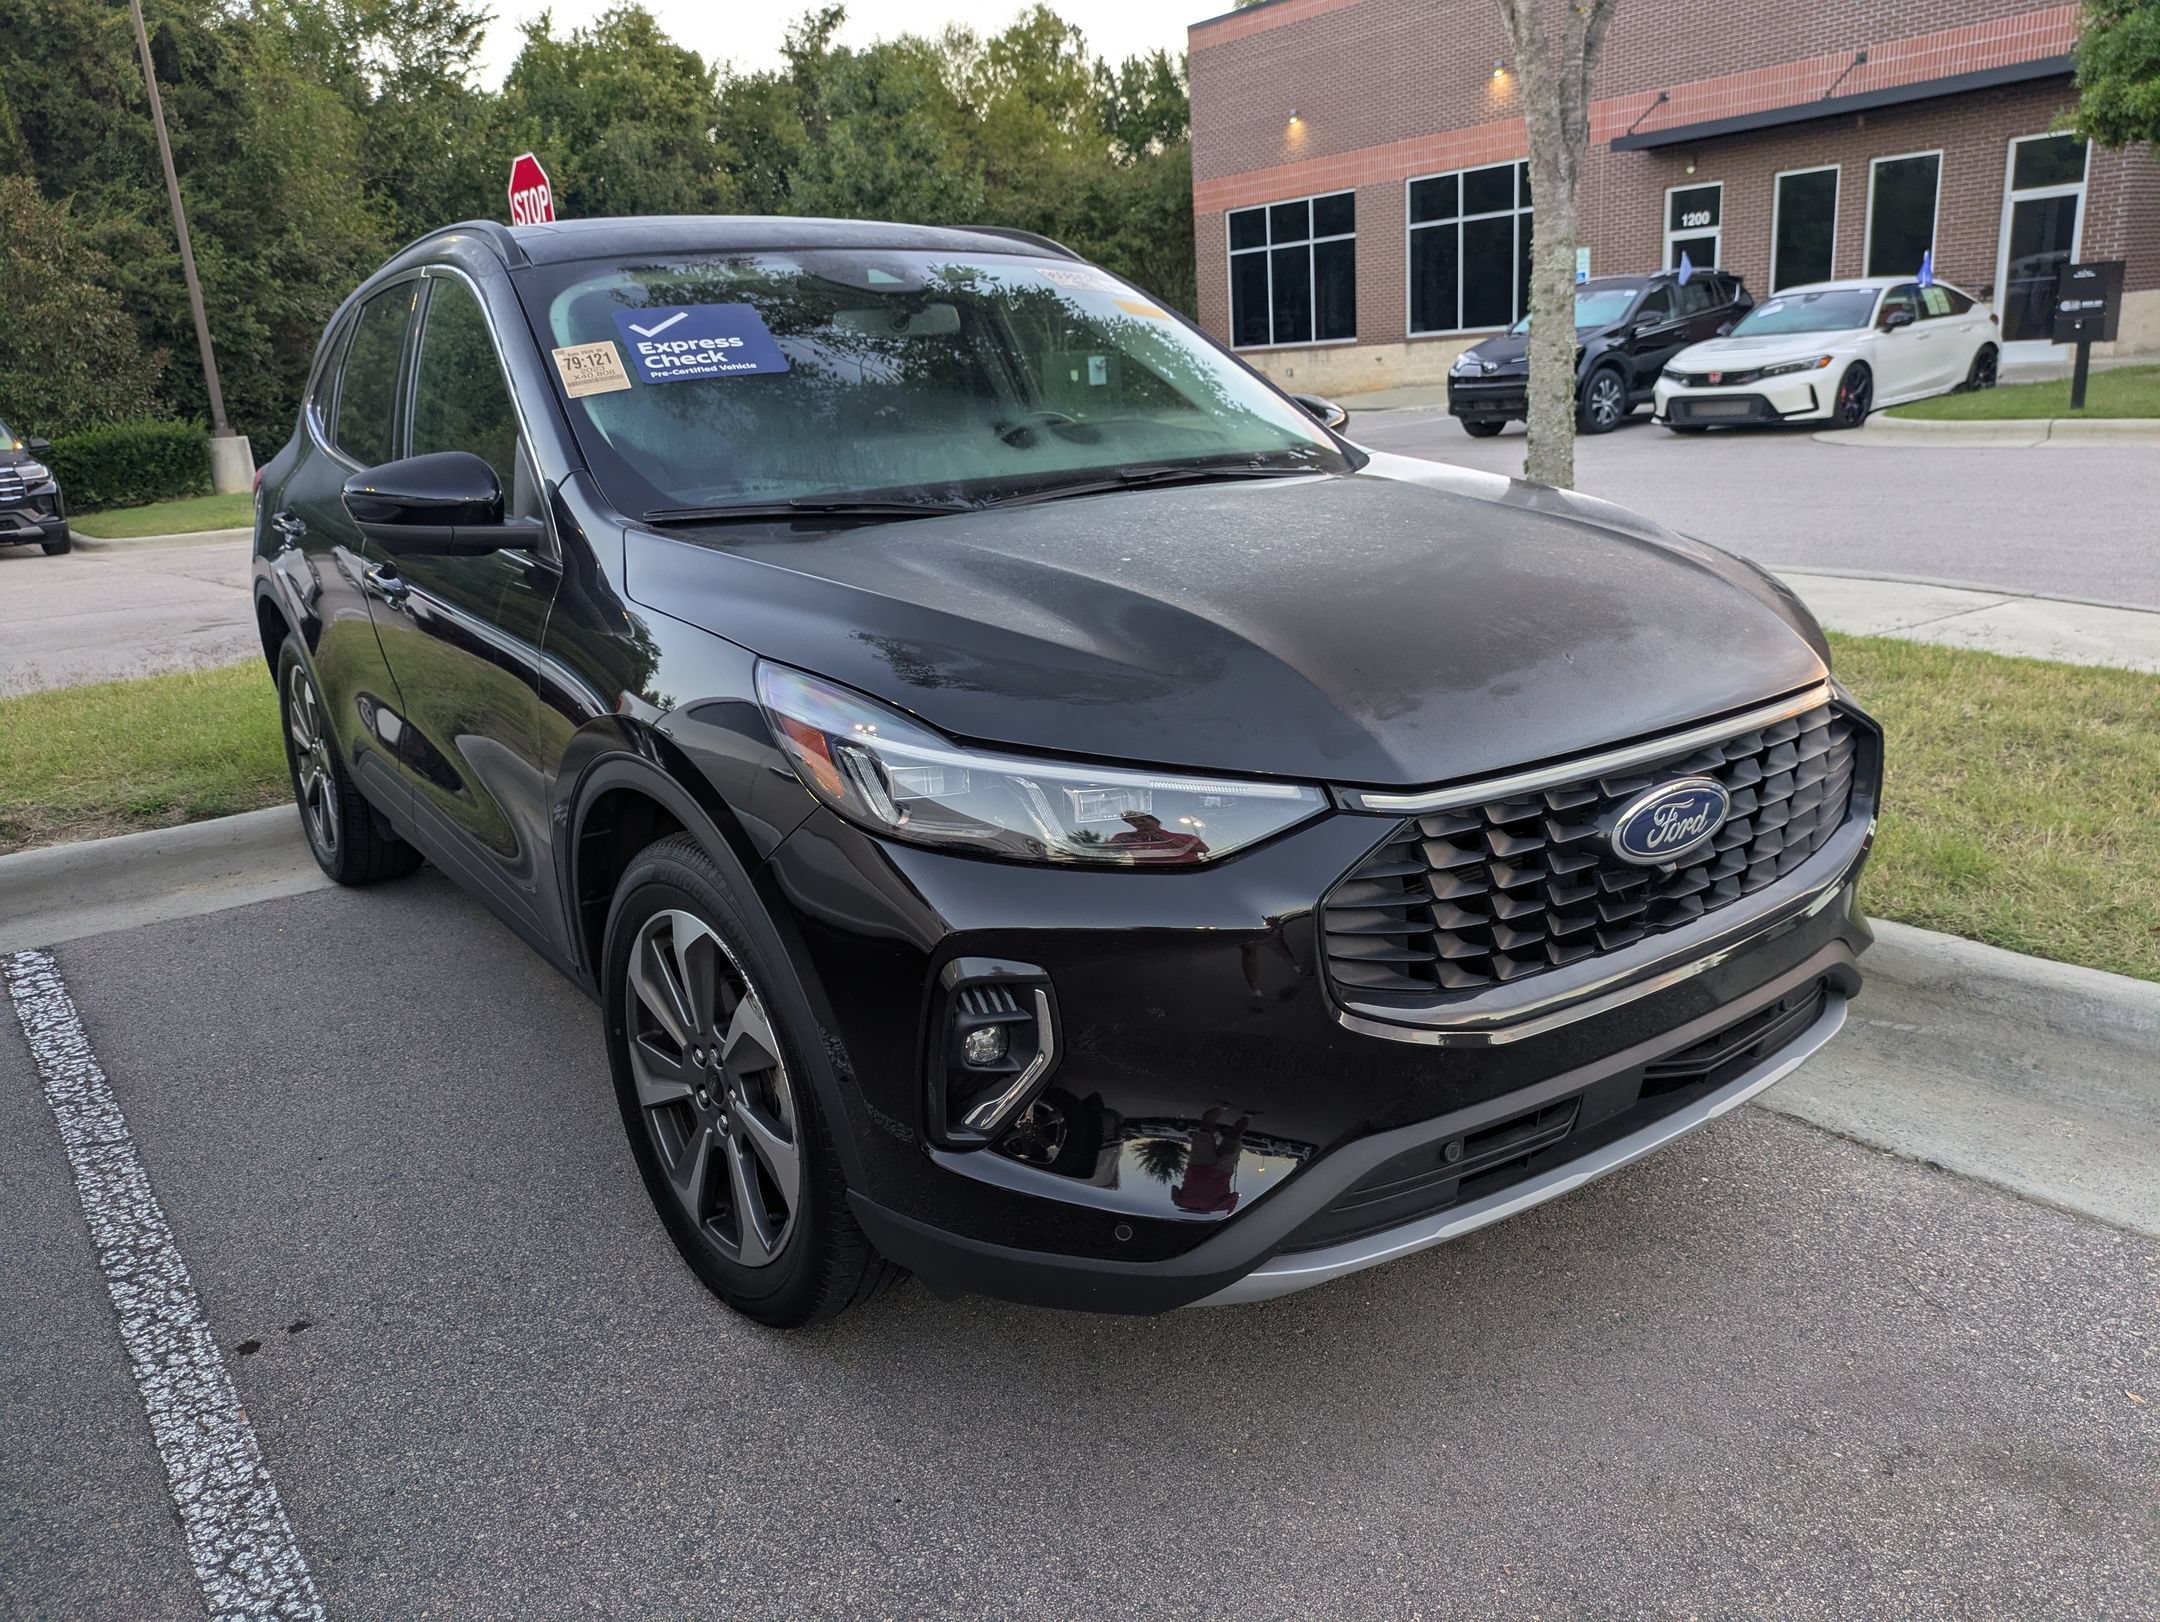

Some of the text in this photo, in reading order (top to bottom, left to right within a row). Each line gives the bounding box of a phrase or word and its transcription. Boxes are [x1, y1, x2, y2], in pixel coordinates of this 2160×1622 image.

[513, 184, 549, 225] STOP
[1681, 210, 1711, 227] 1200
[636, 336, 744, 355] Express
[563, 352, 612, 371] 79:121
[644, 350, 728, 369] Check
[650, 362, 758, 378] Pre-Certified Vehicle
[1646, 797, 1710, 849] Ford
